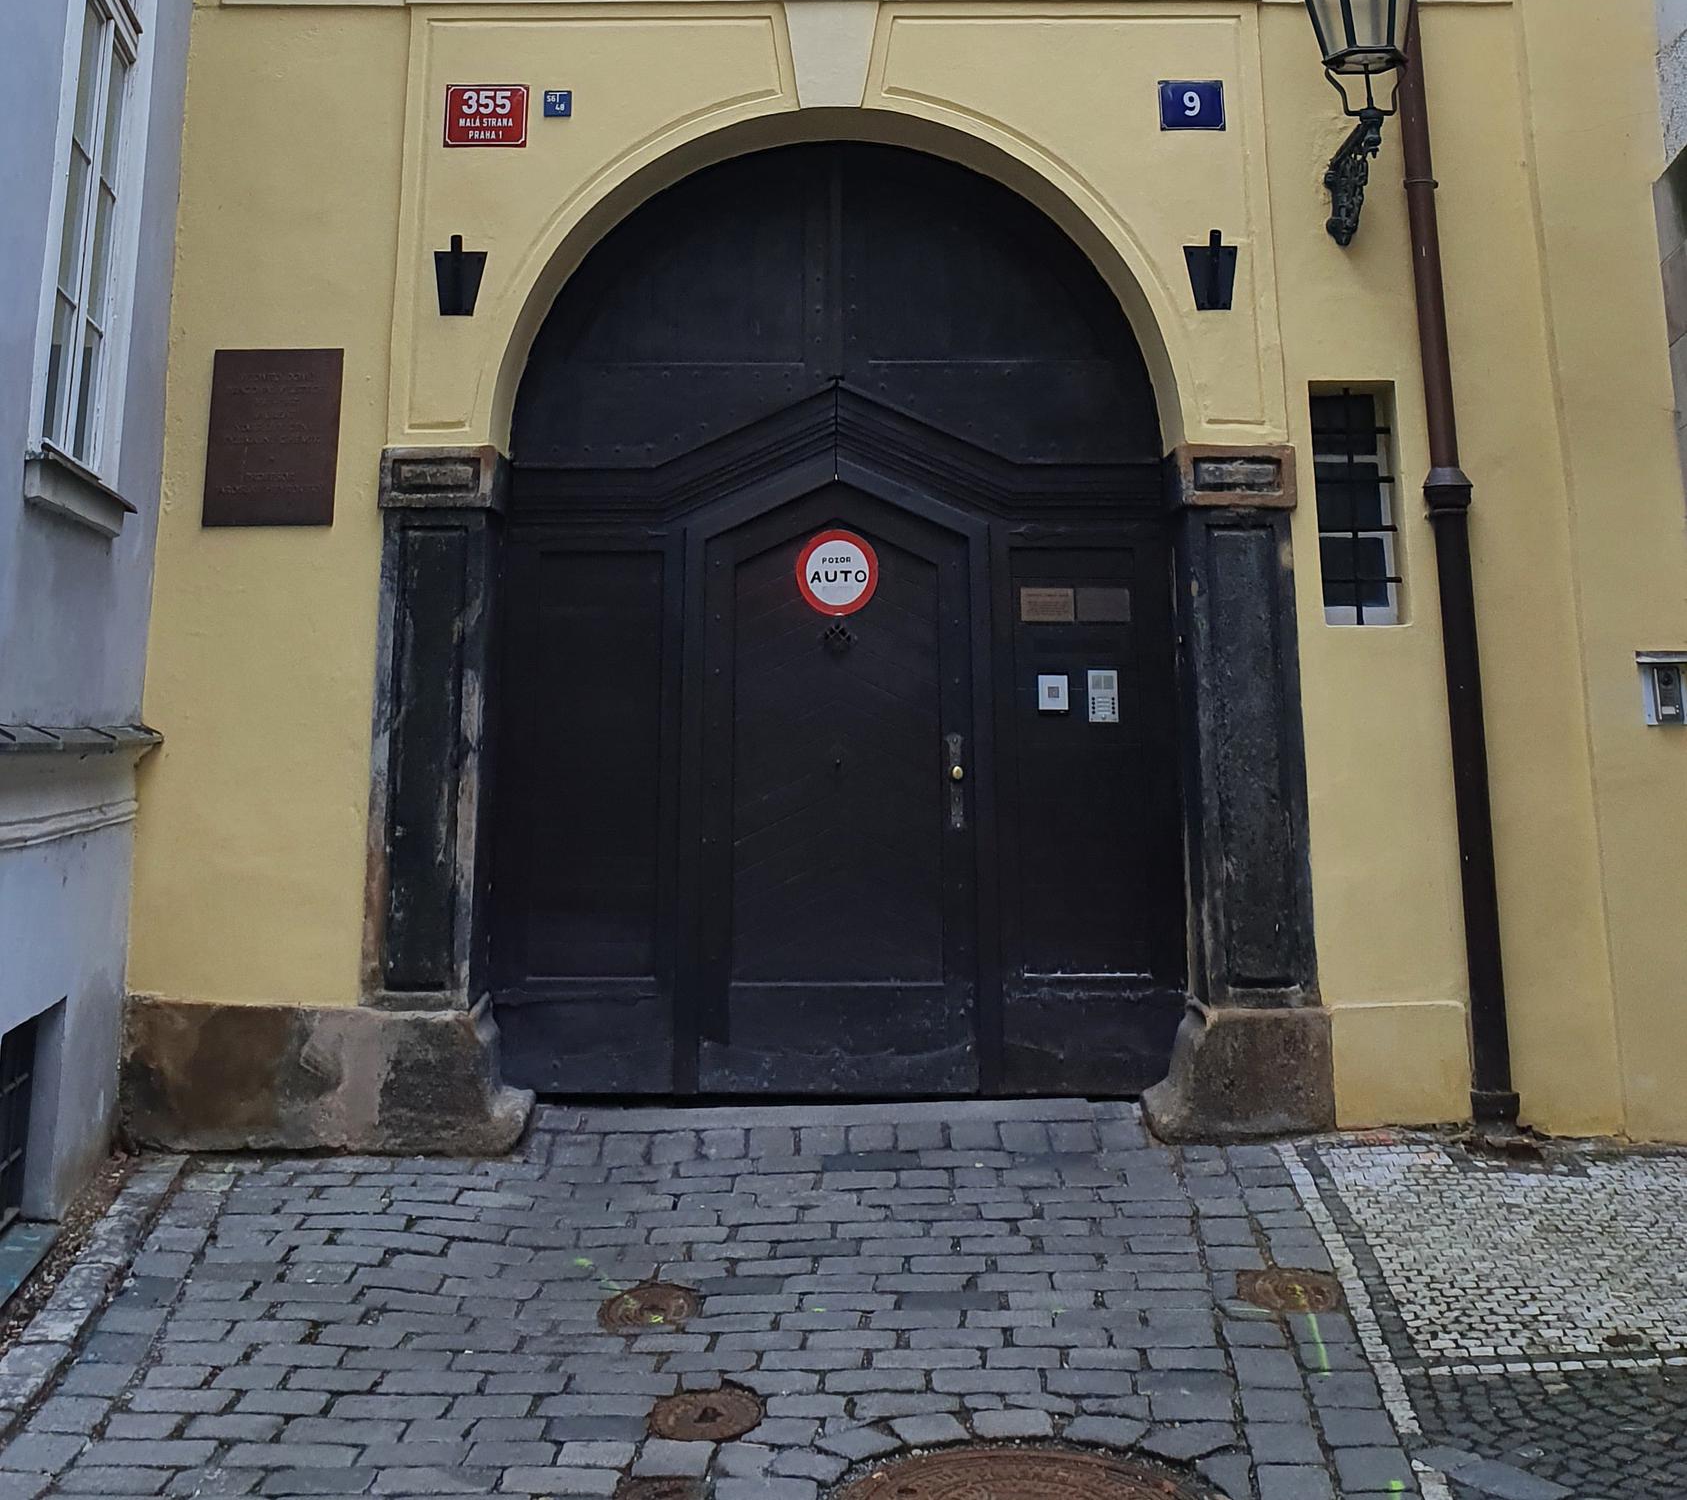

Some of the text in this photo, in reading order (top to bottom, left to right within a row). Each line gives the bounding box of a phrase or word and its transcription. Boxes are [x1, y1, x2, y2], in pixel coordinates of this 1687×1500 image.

[462, 91, 511, 114] 355
[1183, 91, 1200, 116] 9
[459, 116, 513, 127] MALÁ STRANA
[469, 131, 503, 139] PRAHA 1
[821, 556, 851, 564] POZOR
[810, 570, 867, 583] AUTO
